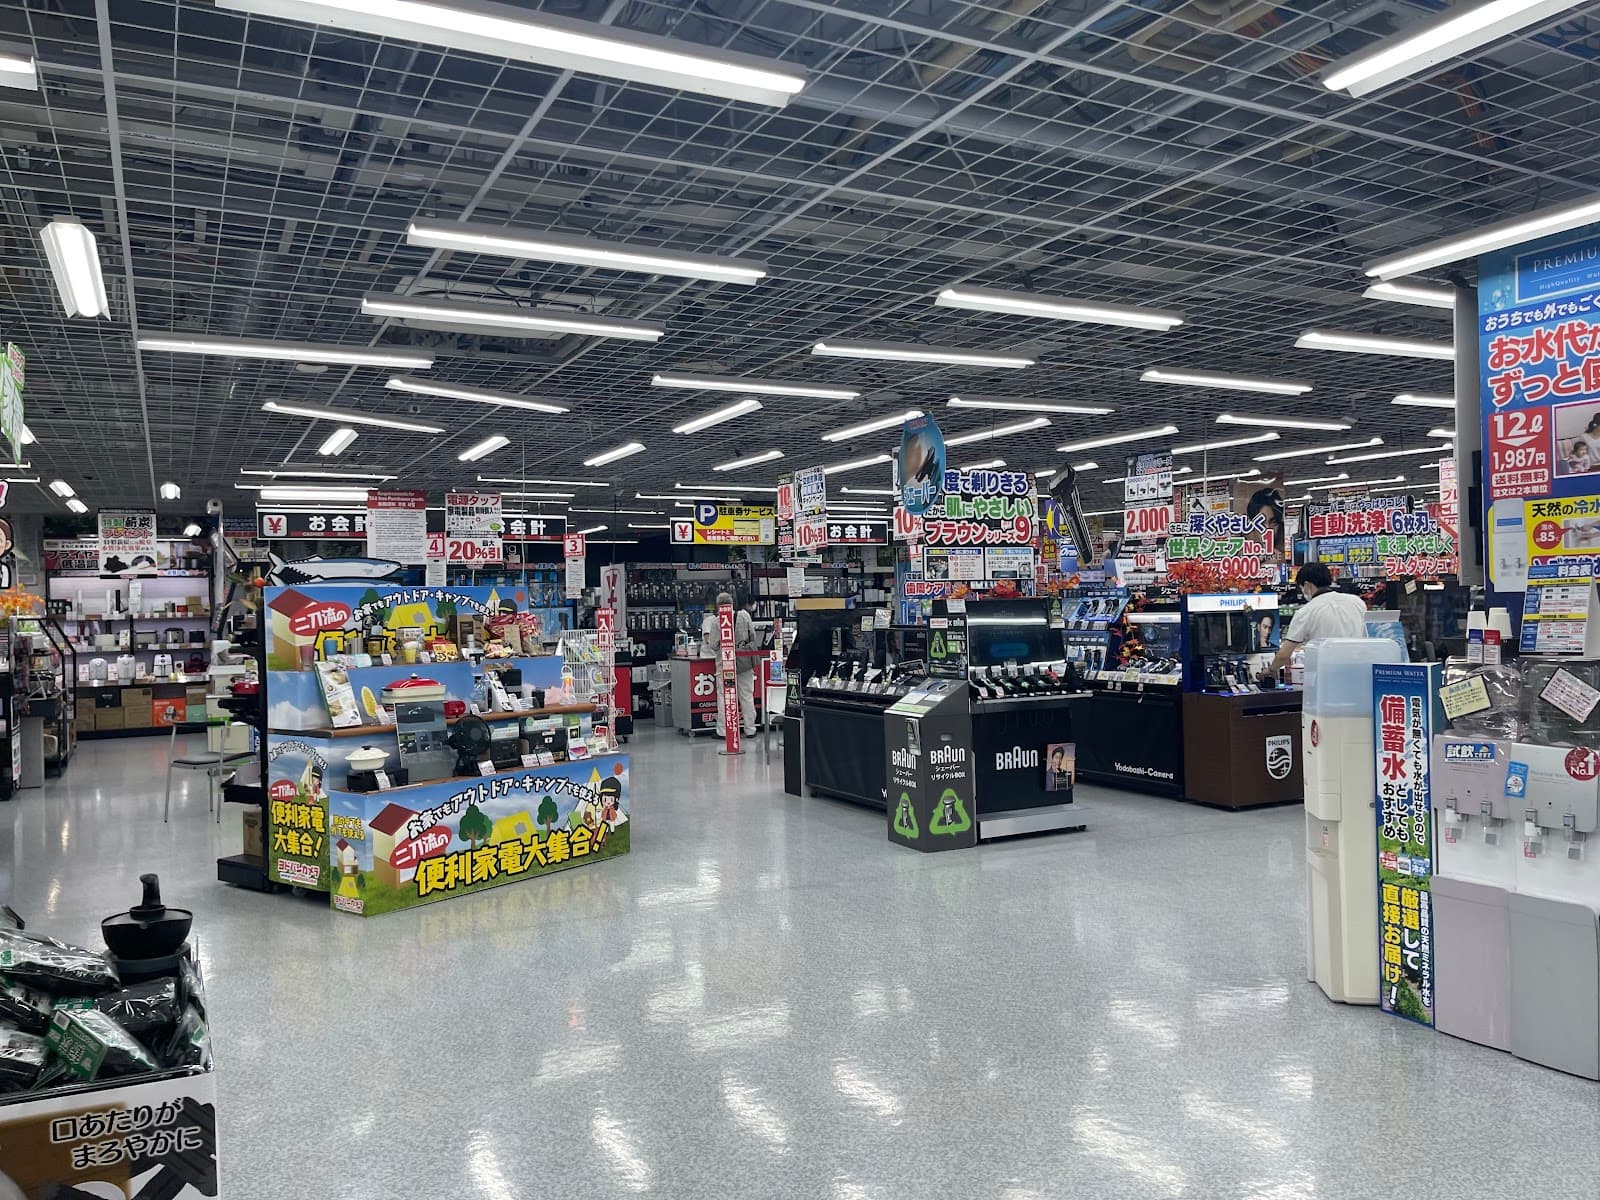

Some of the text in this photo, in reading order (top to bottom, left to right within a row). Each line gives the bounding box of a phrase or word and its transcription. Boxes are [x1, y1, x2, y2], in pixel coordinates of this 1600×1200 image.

[1493, 447, 1546, 471] 1,987円
[719, 506, 774, 516] 駐車券サービス
[1126, 507, 1170, 534] 2,000
[829, 524, 873, 539] お会計
[1385, 556, 1450, 576] ラムダッシュ
[1220, 599, 1247, 607] PHILIPS
[294, 607, 348, 632] 二刀流の
[720, 614, 732, 640] 入口
[1380, 695, 1407, 781] 備蓄水
[930, 745, 966, 765] BRAUN
[995, 746, 1039, 771] BRAUN
[935, 764, 960, 773] シェーバー
[272, 801, 325, 833] 便利家電
[1382, 783, 1396, 839] おすすめ
[395, 832, 450, 864] 二刀流の
[277, 858, 320, 878] ヨドバシカメラ
[1401, 887, 1420, 970] 厳選して
[52, 1100, 184, 1144] 口あたりが
[72, 1127, 203, 1169] まろやかに
